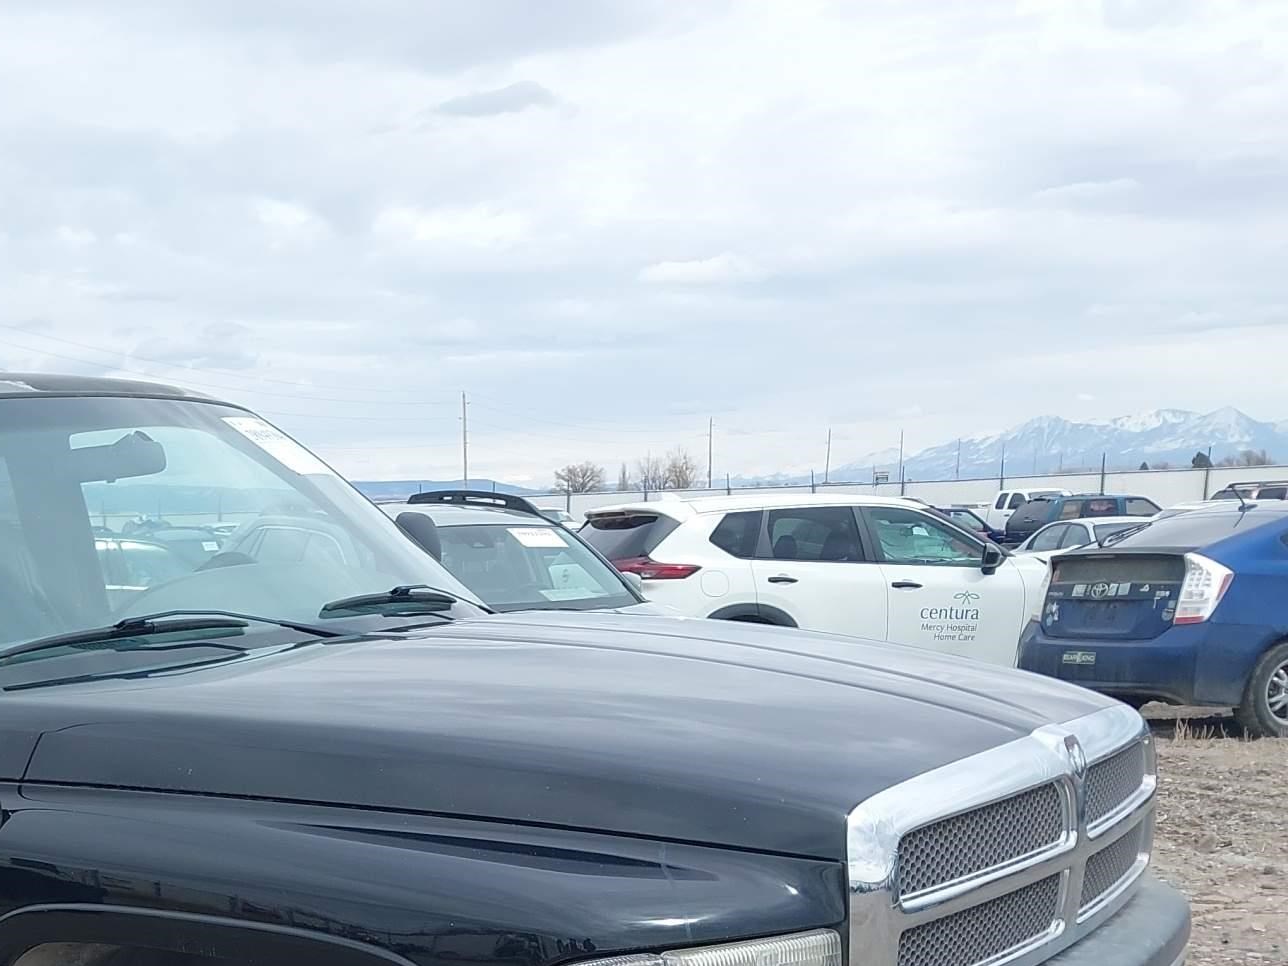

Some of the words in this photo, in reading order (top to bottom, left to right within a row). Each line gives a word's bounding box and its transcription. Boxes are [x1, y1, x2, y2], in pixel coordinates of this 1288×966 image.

[920, 606, 979, 620] centura
[921, 623, 945, 633] Mercy
[946, 623, 978, 633] Hospital
[933, 633, 956, 641] Home
[958, 633, 976, 641] Care
